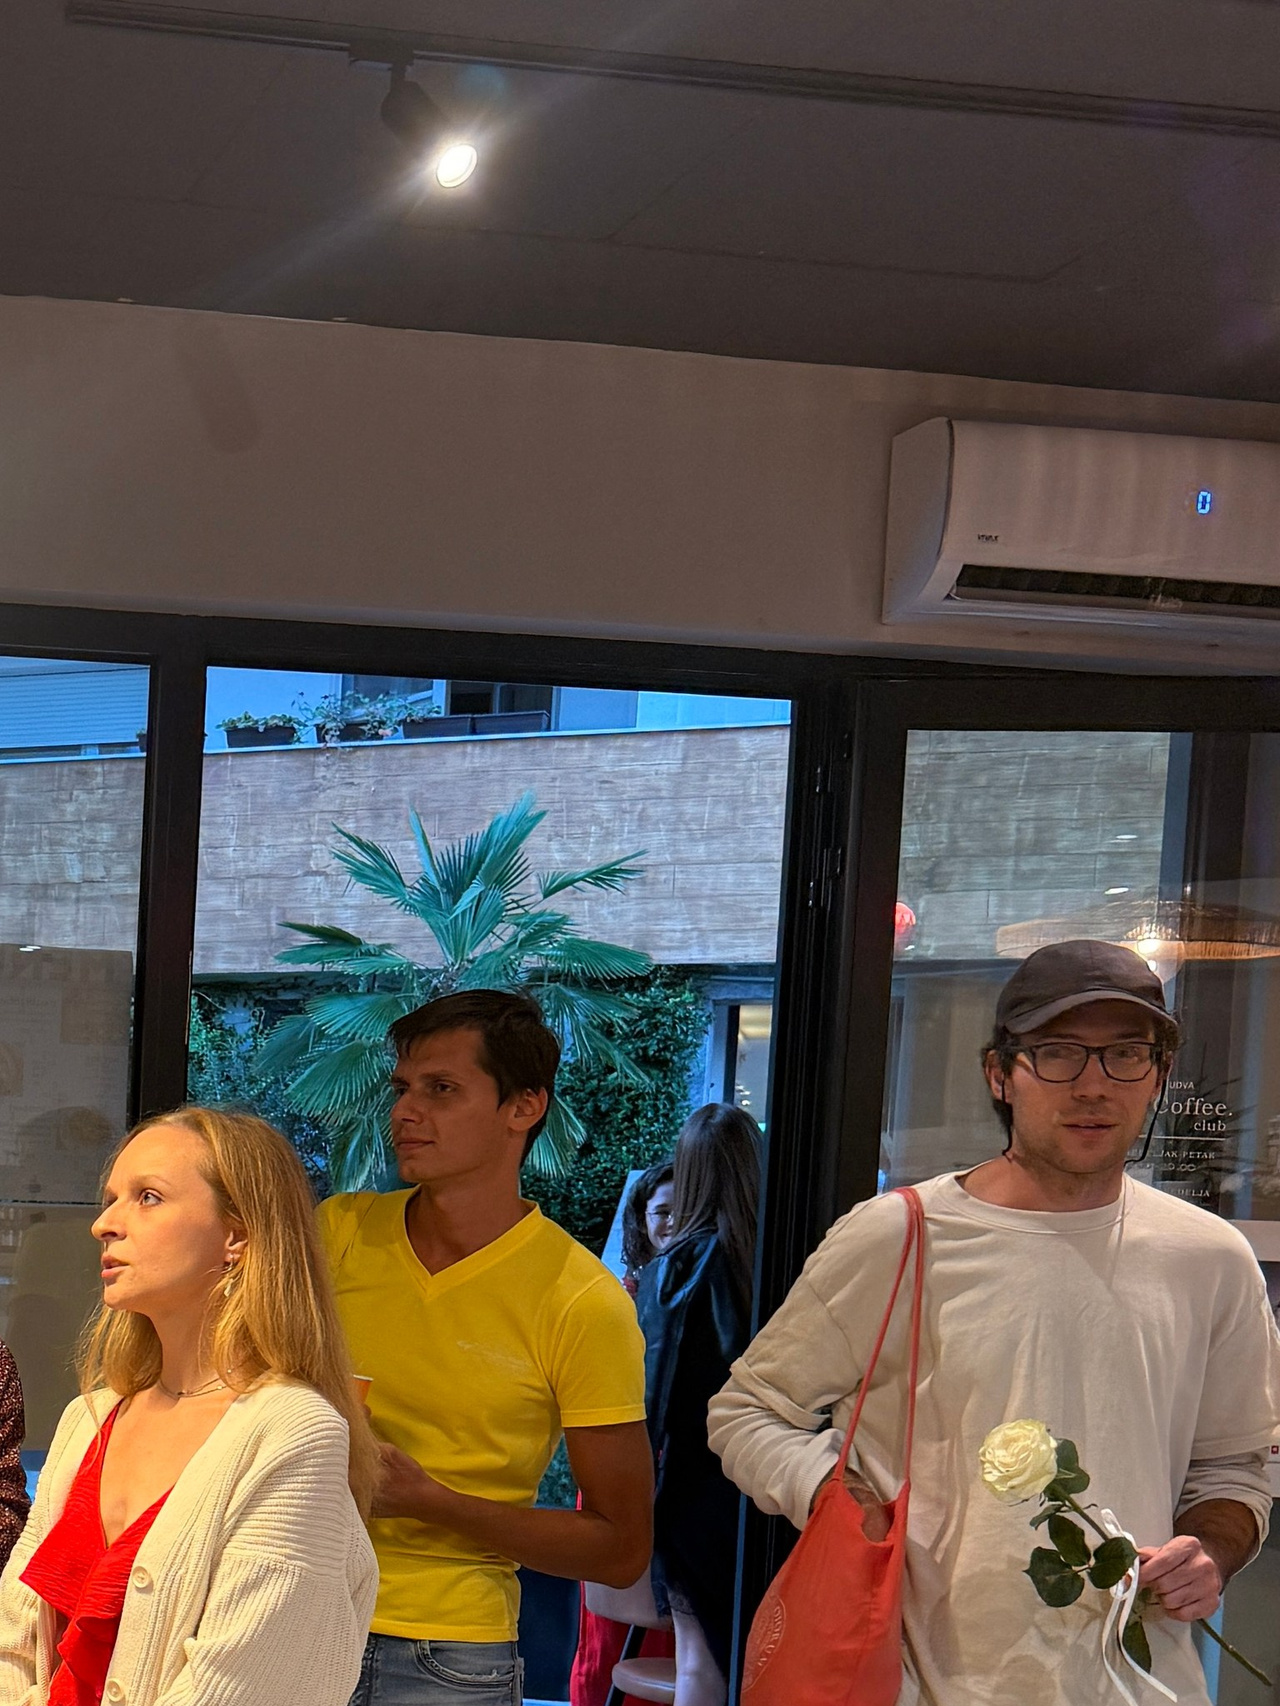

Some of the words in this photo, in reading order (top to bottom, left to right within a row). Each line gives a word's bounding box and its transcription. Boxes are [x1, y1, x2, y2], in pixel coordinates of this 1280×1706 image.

[1197, 491, 1211, 514] 0
[1169, 1081, 1195, 1090] UDVA
[1193, 1120, 1227, 1132] club
